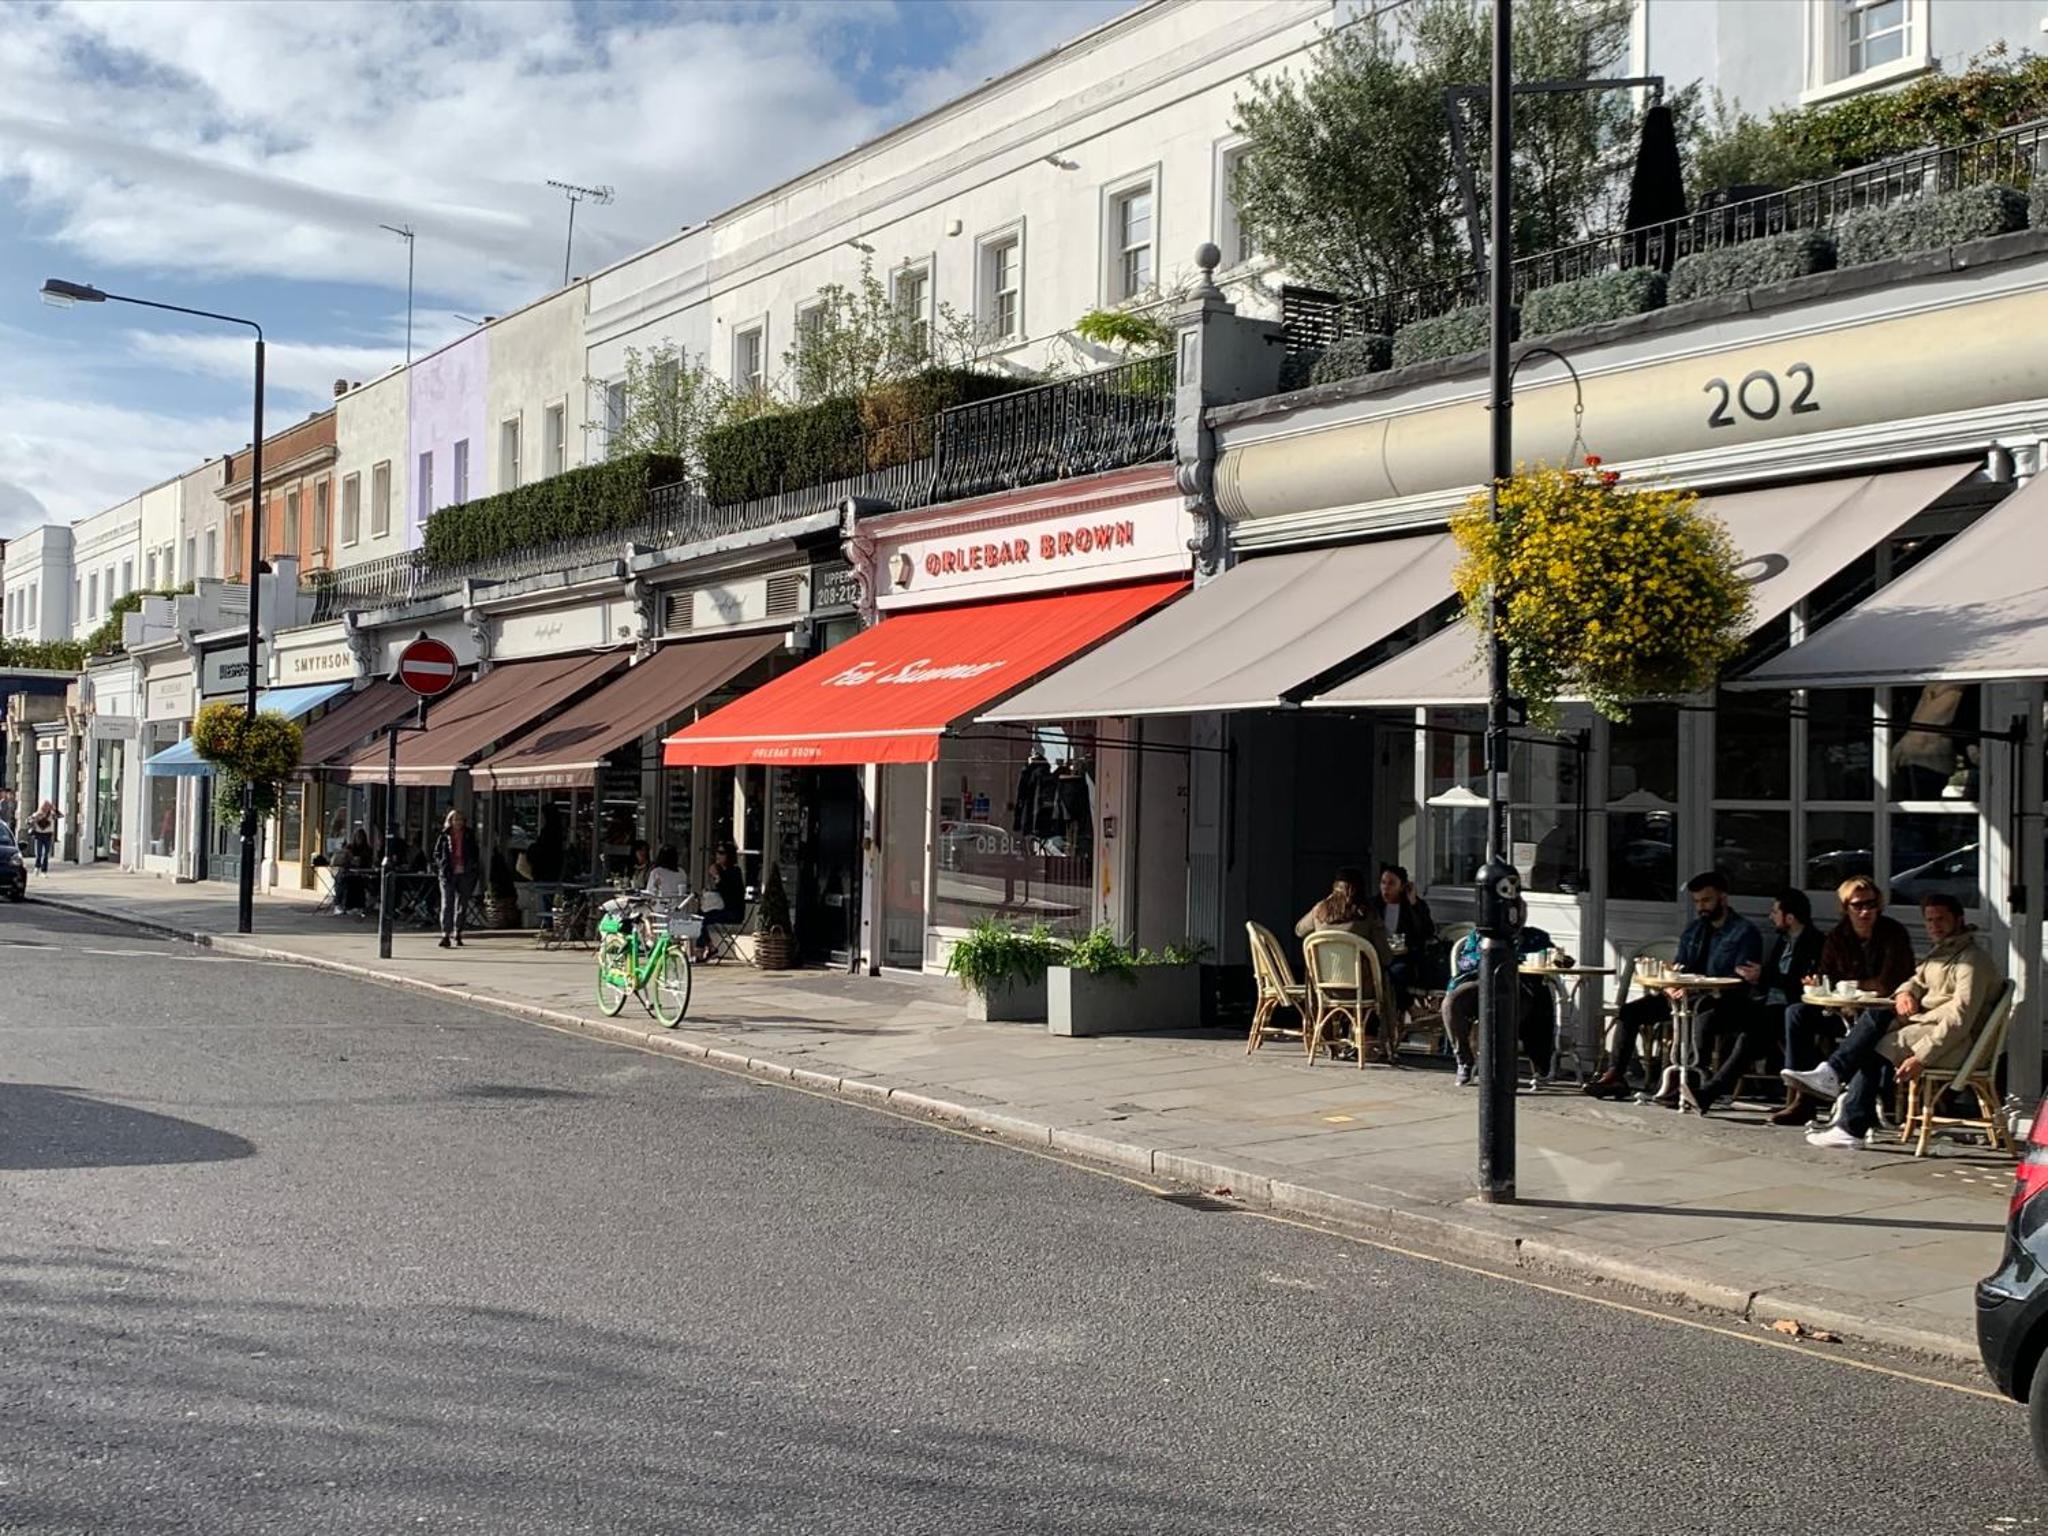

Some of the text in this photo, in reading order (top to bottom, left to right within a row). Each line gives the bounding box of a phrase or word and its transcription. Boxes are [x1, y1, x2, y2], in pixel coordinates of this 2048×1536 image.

[1703, 361, 1821, 428] 202
[925, 520, 1134, 577] ORLEBAR BROWN
[294, 652, 350, 673] SMYTHSON
